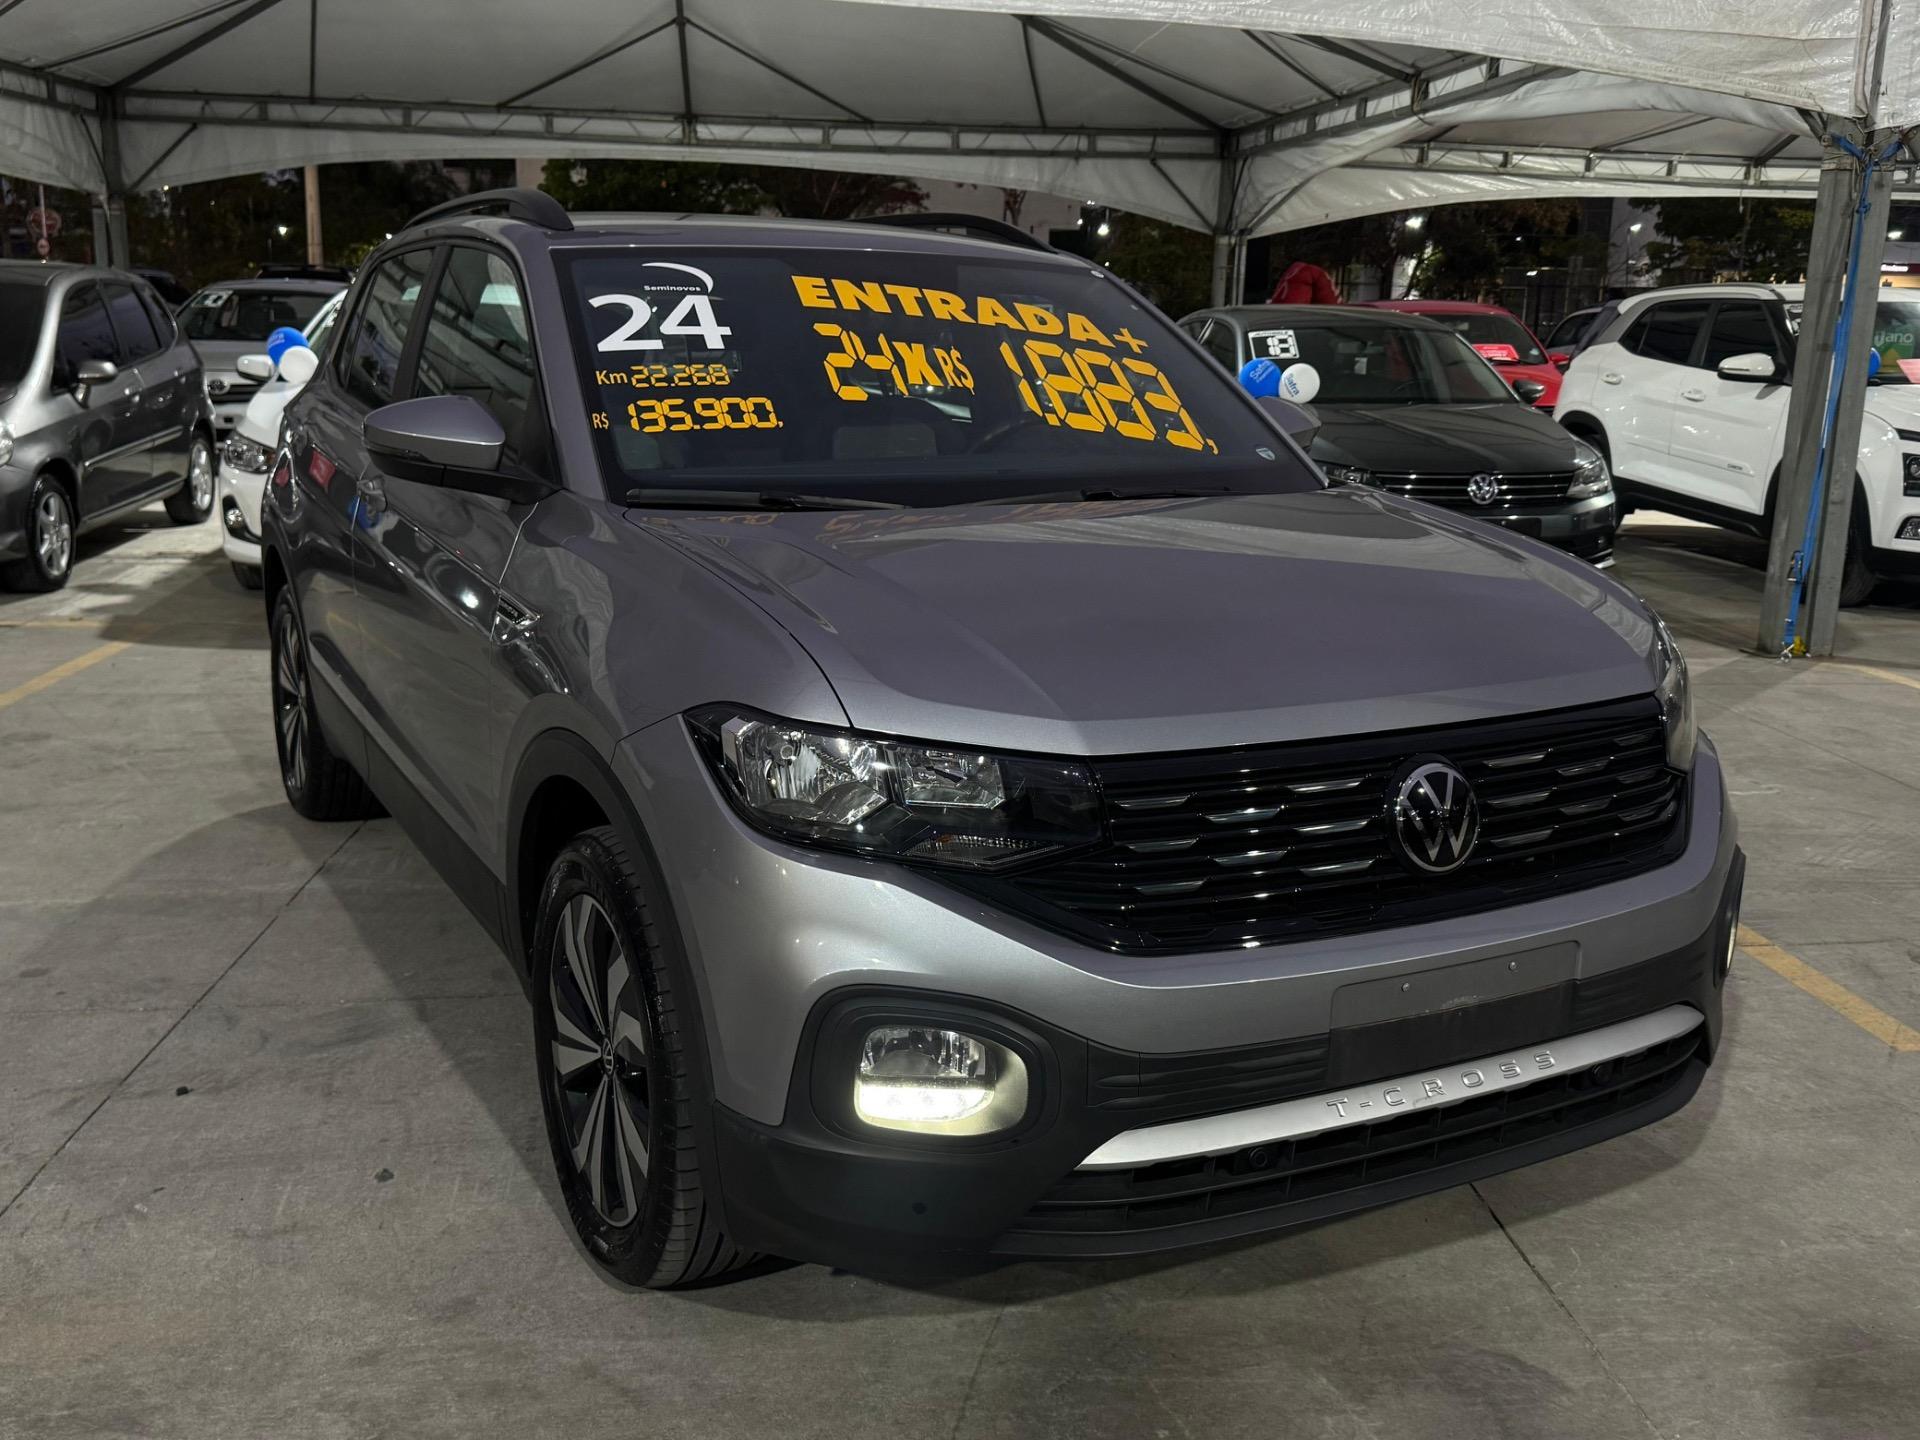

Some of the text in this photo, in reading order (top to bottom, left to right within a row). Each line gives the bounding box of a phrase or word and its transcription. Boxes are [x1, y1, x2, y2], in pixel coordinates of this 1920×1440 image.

[643, 284, 702, 292] Seminovos
[588, 293, 733, 353] 24
[594, 363, 731, 388] Km 22.268
[592, 411, 609, 430] R$
[1325, 1049, 1556, 1118] T-CROSS
